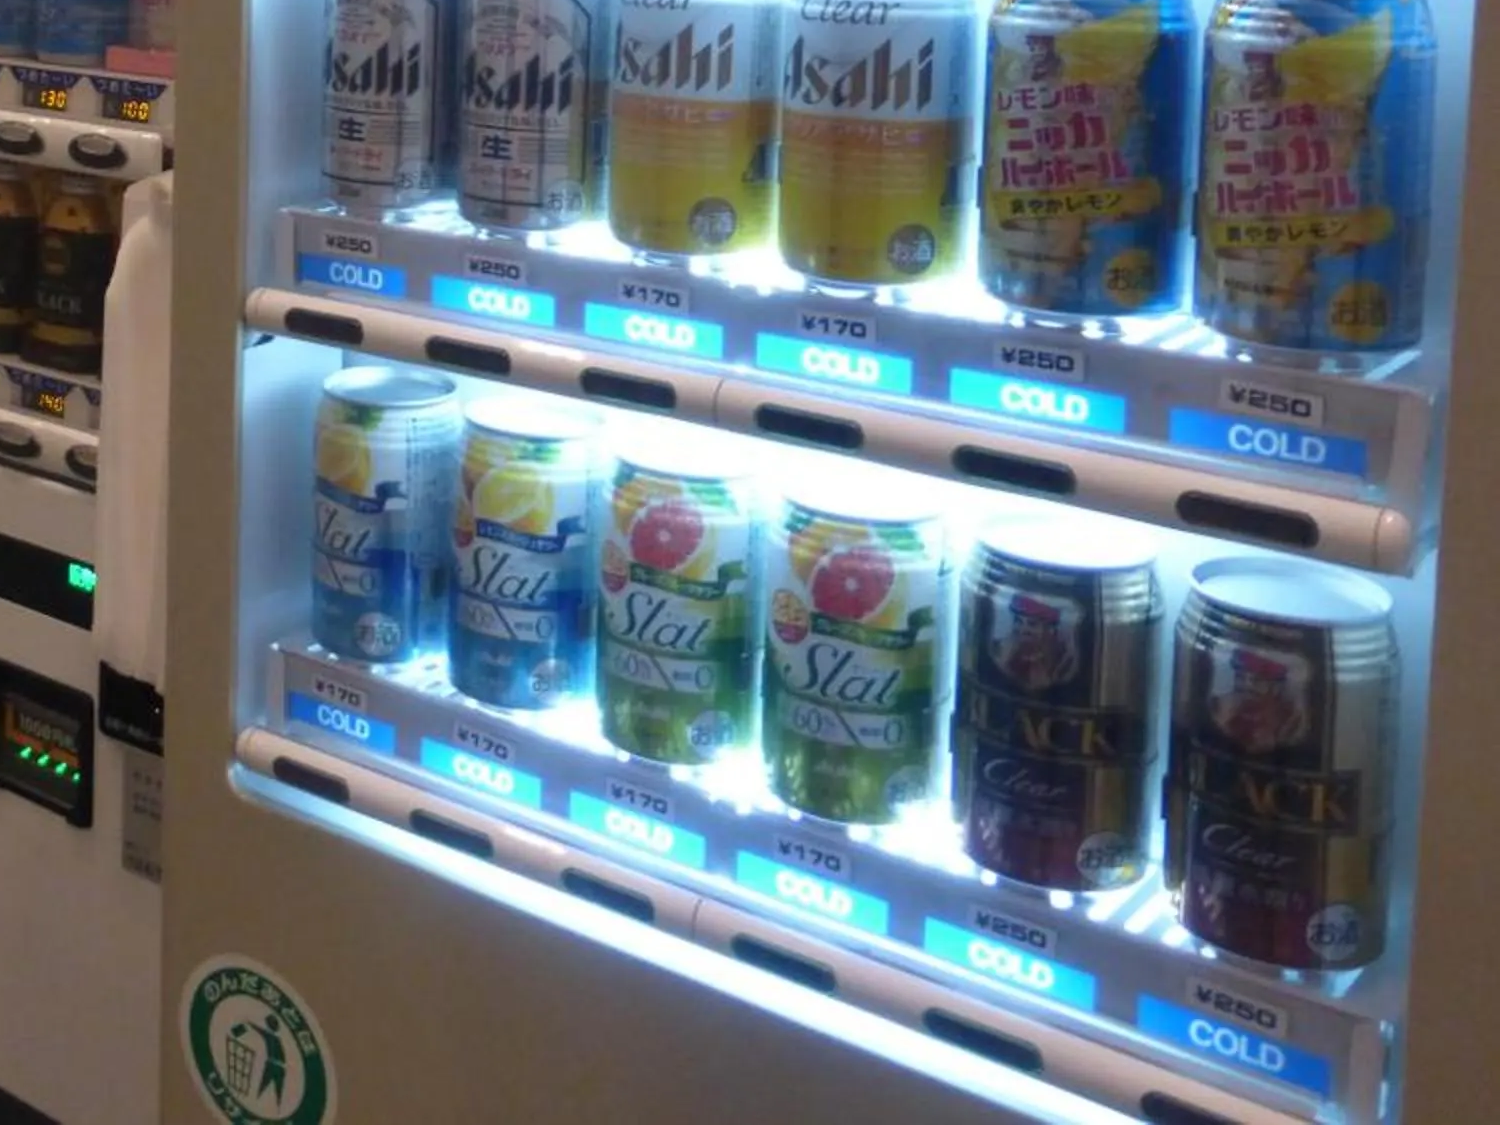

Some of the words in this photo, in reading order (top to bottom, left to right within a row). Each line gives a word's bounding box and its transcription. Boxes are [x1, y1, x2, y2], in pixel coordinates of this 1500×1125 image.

[617, 21, 735, 93] sahi
[783, 36, 935, 112] Asahi
[337, 117, 367, 143] 生
[481, 134, 514, 160] 生
[1006, 110, 1107, 152] ニッカ
[1223, 135, 1332, 175] ニッカ
[325, 231, 372, 256] ¥250
[328, 260, 383, 290] COLD
[467, 258, 521, 283] ¥250
[467, 285, 532, 319] COLD
[621, 283, 680, 309] ¥170
[624, 315, 695, 349] COLD
[803, 313, 868, 341] ¥170
[802, 346, 881, 384] COLD
[1001, 345, 1075, 374] ¥250
[1000, 381, 1089, 424] COLD
[1229, 383, 1312, 419] ¥250
[1227, 423, 1327, 465] COLD
[464, 543, 551, 603] Slat
[624, 589, 712, 653] Slat
[805, 641, 901, 705] Slat
[314, 679, 362, 709] ¥170
[316, 705, 371, 741] COLD
[457, 724, 509, 761] ¥170
[451, 755, 515, 795] COLD
[610, 781, 669, 816] ¥170
[604, 808, 674, 854] COLD
[777, 837, 842, 873] ¥170
[774, 871, 853, 918] COLD
[974, 908, 1048, 949] ¥250
[967, 941, 1055, 991] COLD
[1194, 983, 1278, 1029] ¥250
[1187, 1017, 1286, 1074] COLD
